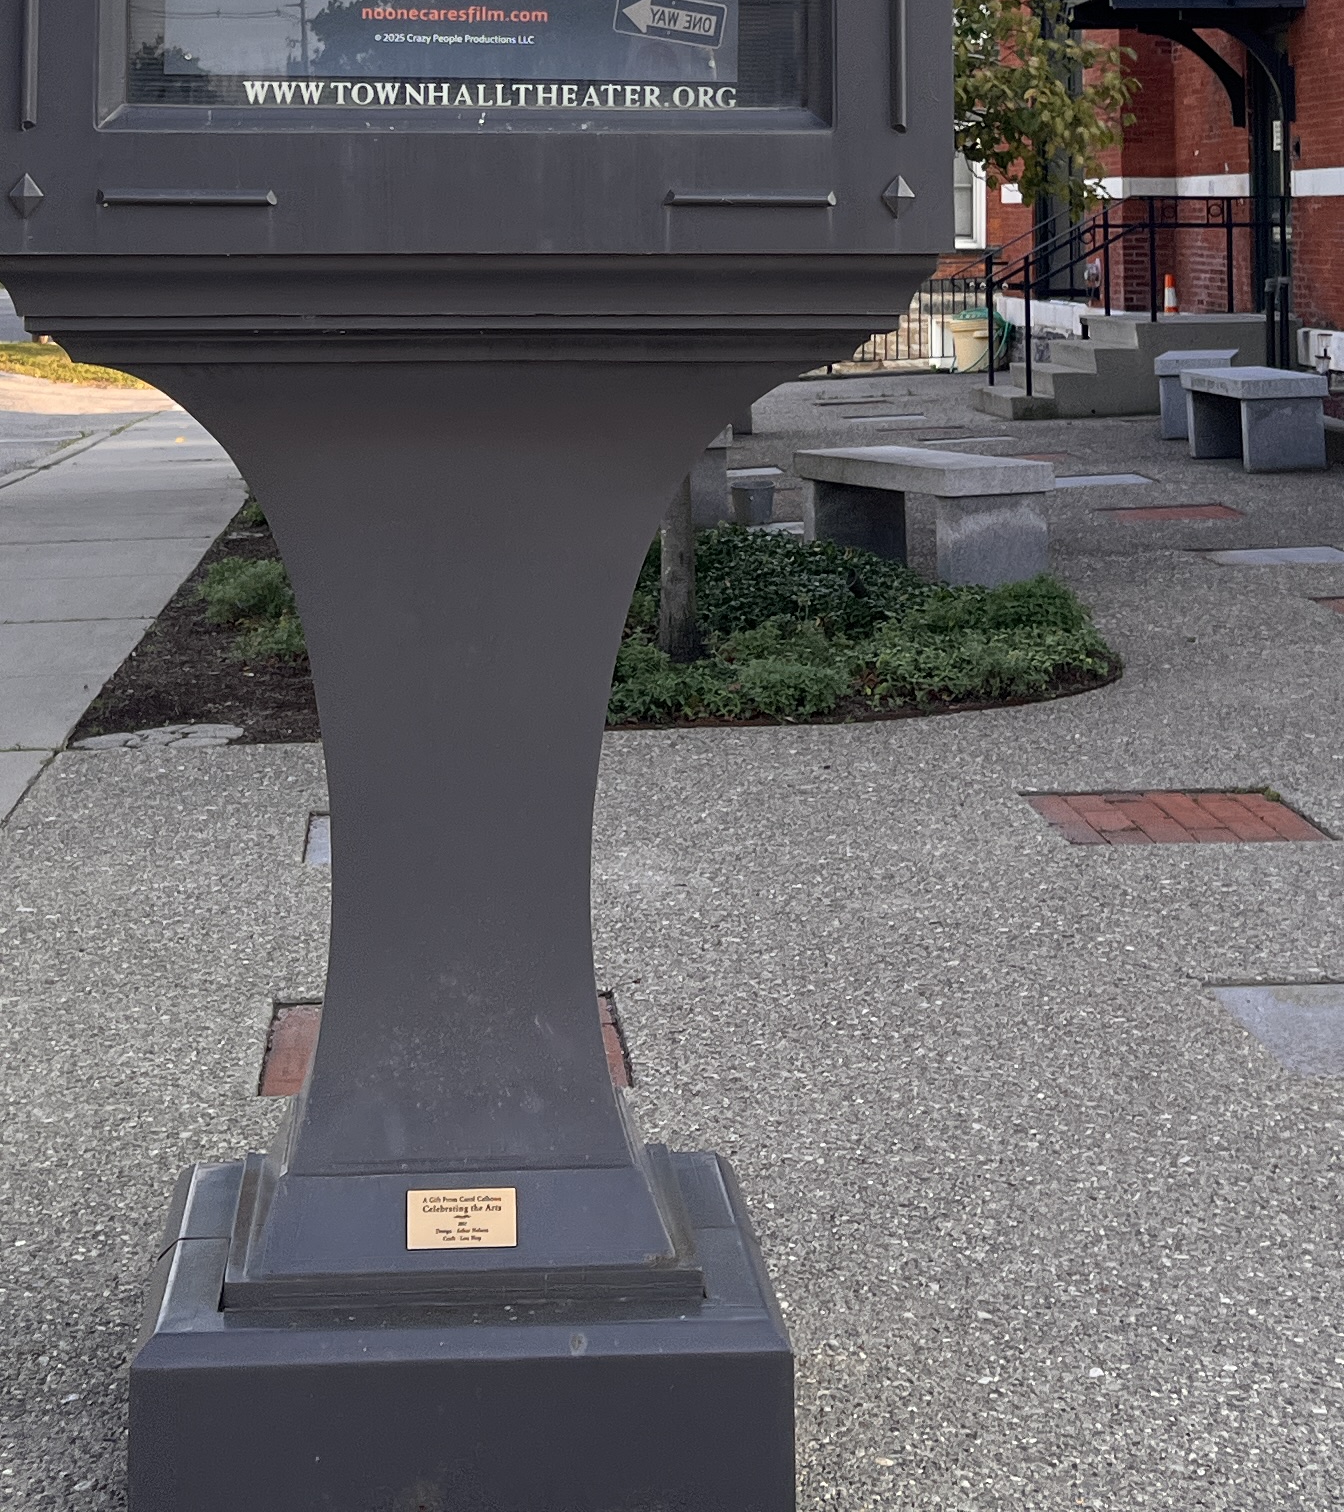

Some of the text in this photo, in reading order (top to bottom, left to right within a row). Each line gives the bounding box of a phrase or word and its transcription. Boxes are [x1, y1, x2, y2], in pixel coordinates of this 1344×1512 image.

[361, 6, 548, 23] noonecaresfilm.com
[383, 34, 405, 42] 2025
[407, 34, 431, 44] Crazy
[433, 34, 463, 45] People
[465, 35, 516, 44] Productions
[518, 36, 534, 44] LLC
[423, 1205, 468, 1213] Celebrating
[471, 1204, 483, 1212] the
